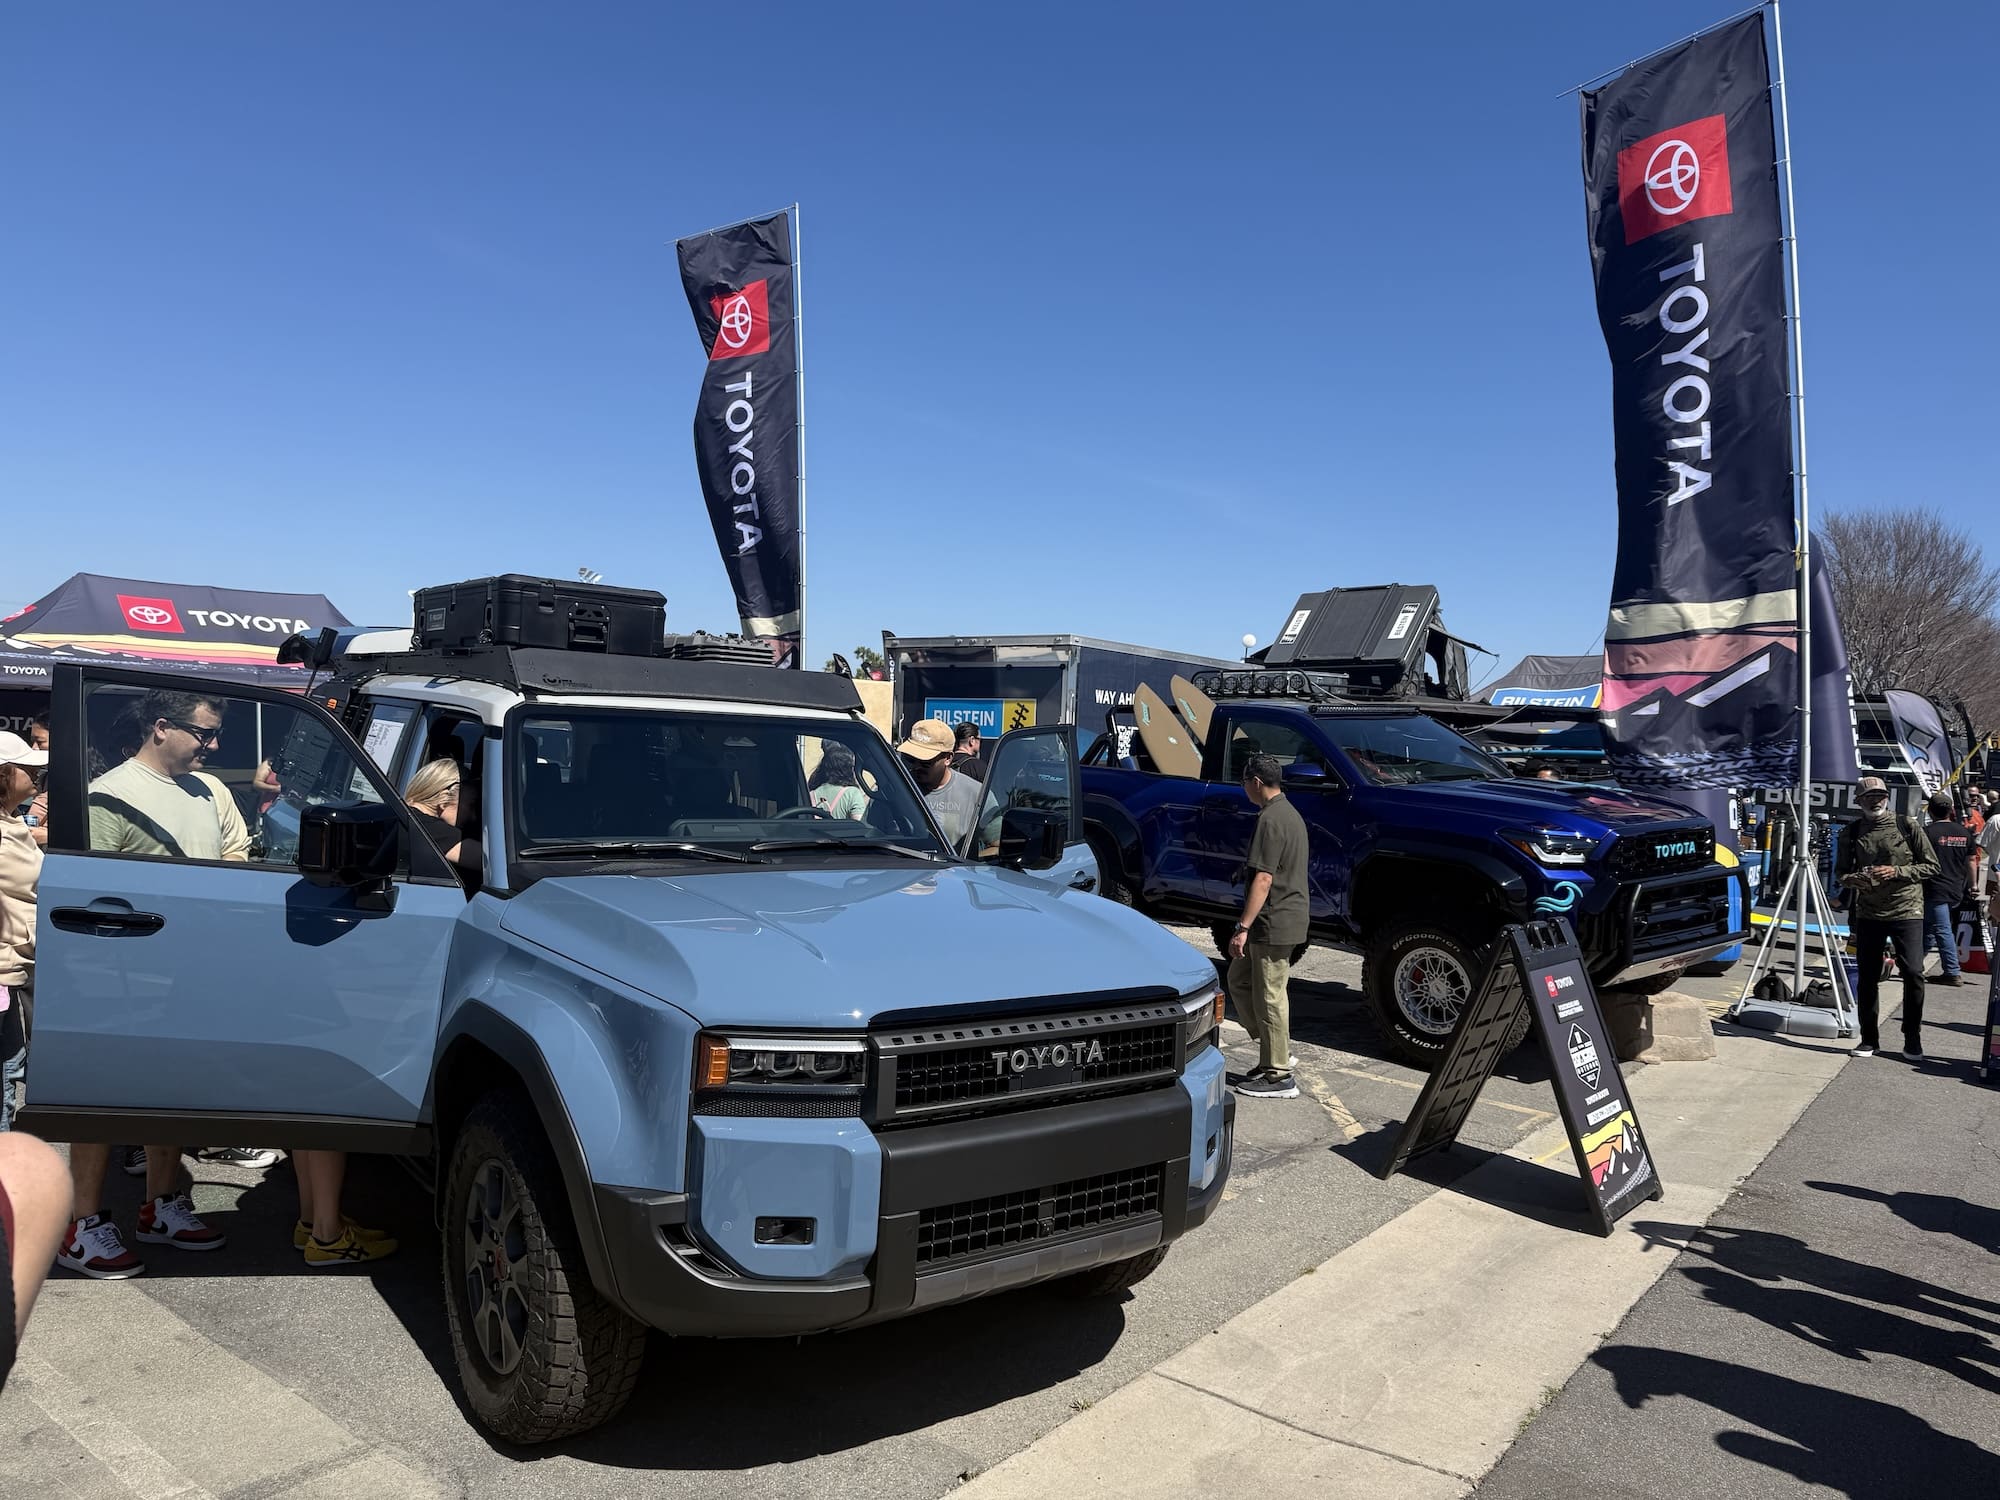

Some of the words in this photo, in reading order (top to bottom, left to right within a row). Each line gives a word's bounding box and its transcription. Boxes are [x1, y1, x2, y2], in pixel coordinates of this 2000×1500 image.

[1658, 243, 1713, 508] TOYOTA
[724, 371, 763, 555] TOYOTA
[187, 609, 312, 634] TOYOTA
[3, 665, 47, 676] TOYOTA
[1095, 689, 1116, 704] WAY
[928, 801, 961, 811] VISION
[1764, 782, 1898, 812] BILSTE
[1655, 841, 1696, 859] TOYOTA
[992, 1039, 1104, 1075] TOYOTA
